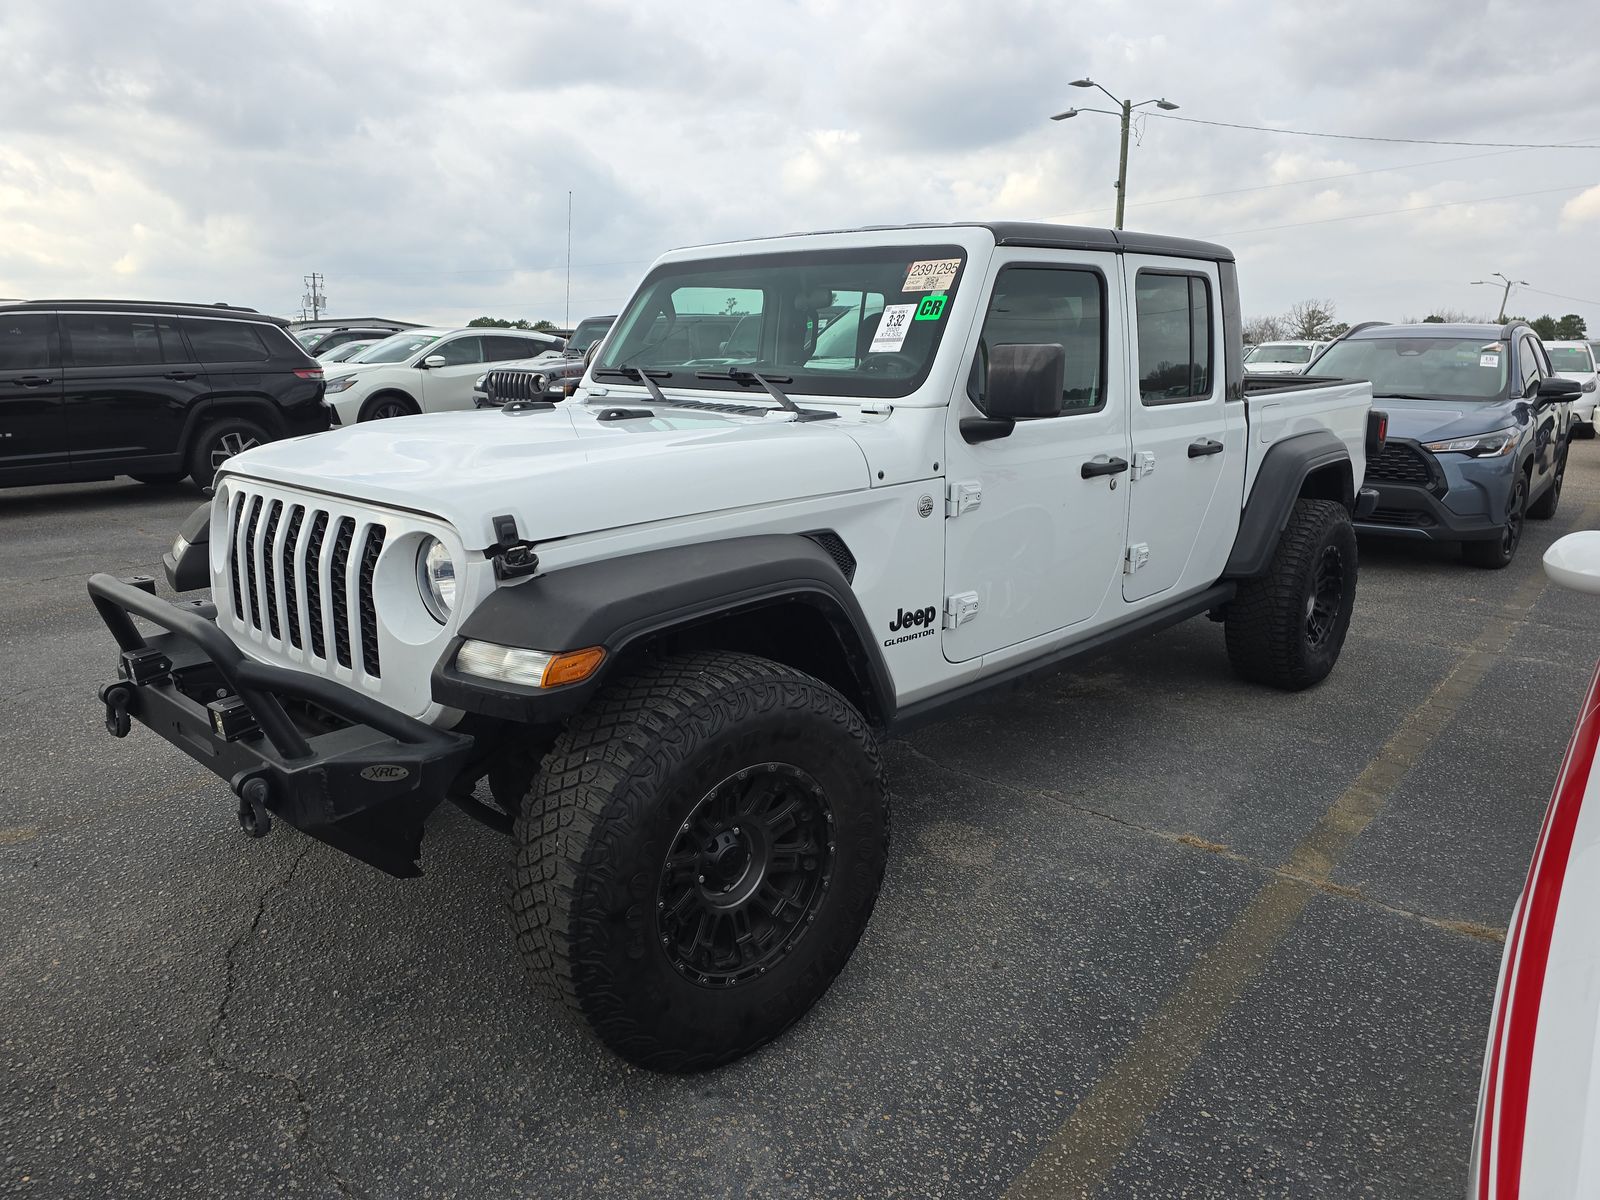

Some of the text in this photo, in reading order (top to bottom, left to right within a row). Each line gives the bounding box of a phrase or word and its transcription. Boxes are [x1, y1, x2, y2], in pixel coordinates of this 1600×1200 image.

[910, 262, 960, 277] 2391295
[920, 299, 944, 316] CR
[886, 314, 906, 328] 3:32
[889, 605, 936, 632] Jeep
[883, 628, 935, 647] GLADIATOR
[369, 766, 400, 779] XRC
